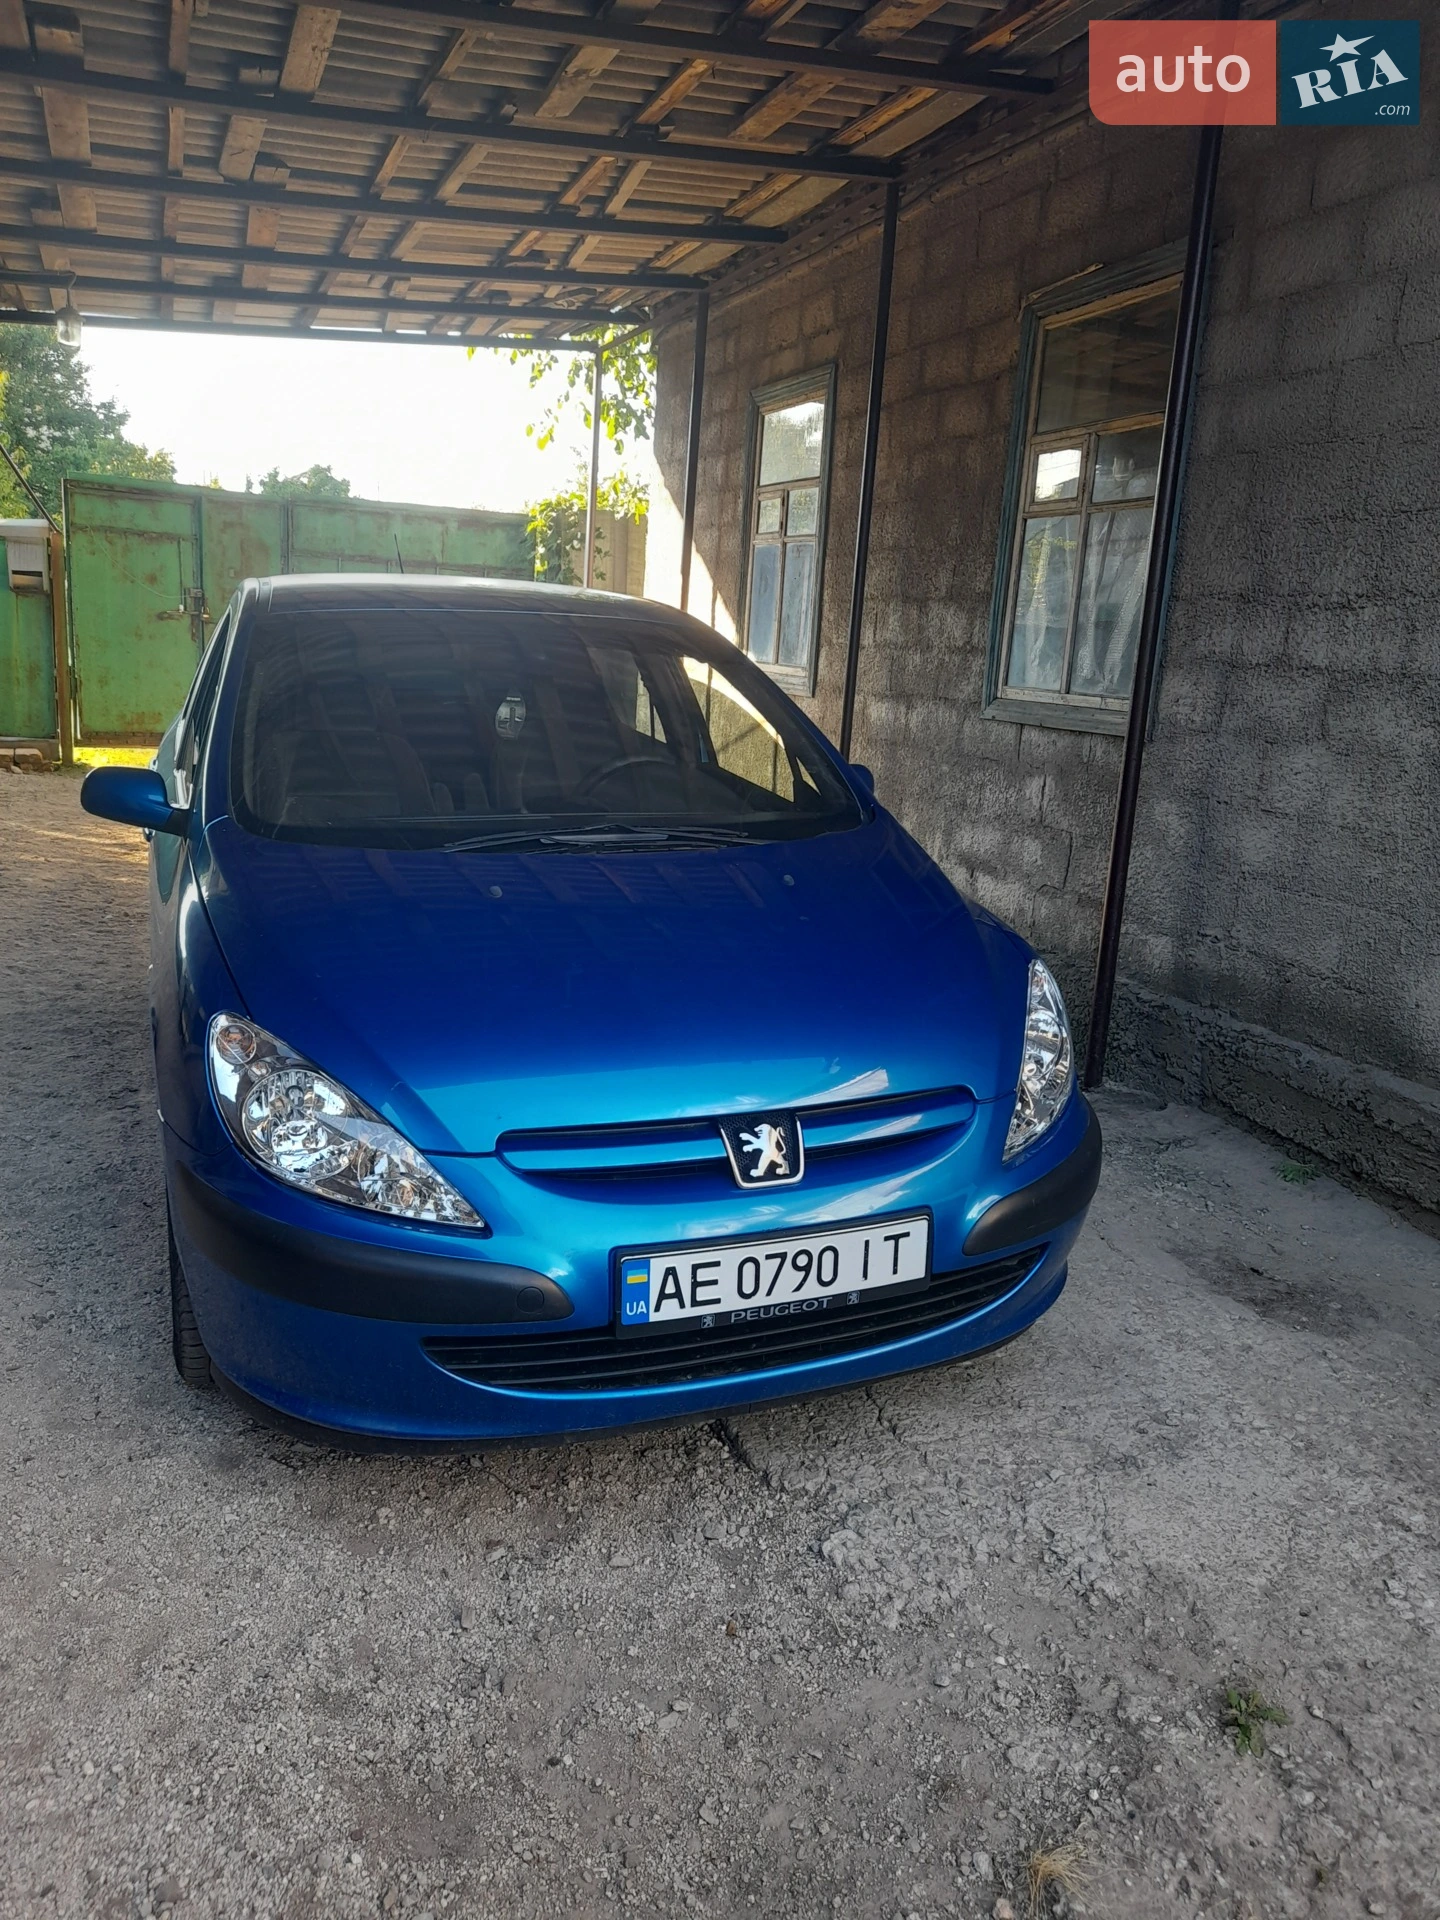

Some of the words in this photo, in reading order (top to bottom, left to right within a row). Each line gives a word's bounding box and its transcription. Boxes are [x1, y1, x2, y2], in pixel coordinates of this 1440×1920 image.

[653, 1260, 721, 1313] AE
[737, 1245, 839, 1300] 0790
[626, 1301, 647, 1316] UA
[731, 1297, 833, 1323] PEUGEOT
